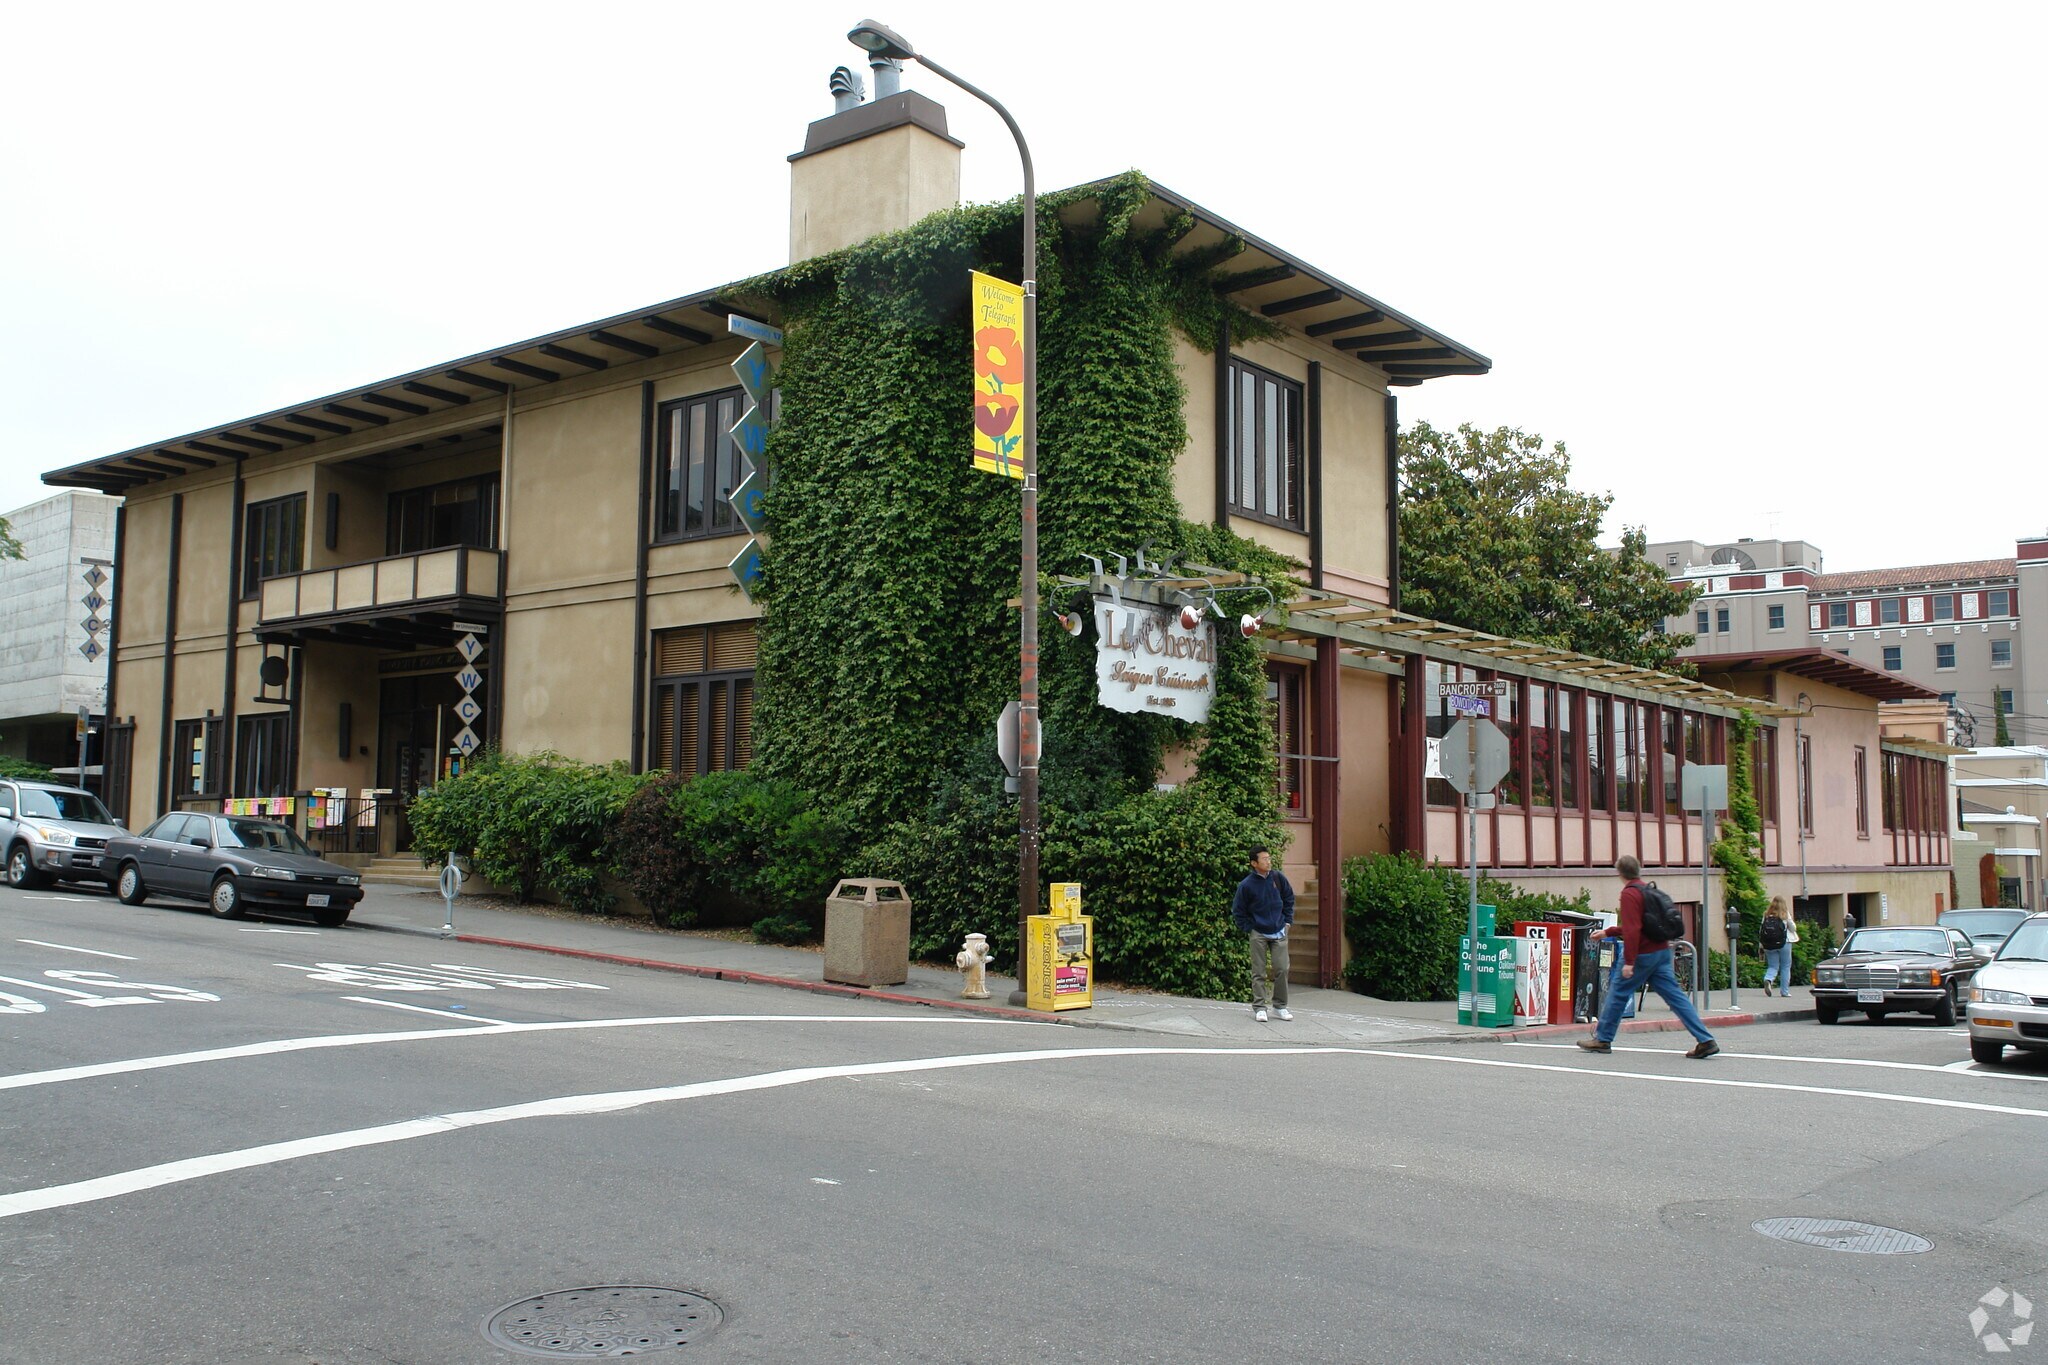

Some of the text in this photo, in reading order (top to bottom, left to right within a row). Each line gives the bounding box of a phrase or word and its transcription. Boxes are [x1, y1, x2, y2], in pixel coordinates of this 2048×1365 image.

[982, 286, 1015, 304] Welcome
[997, 301, 1004, 310] to
[981, 305, 1016, 326] Telegraph
[87, 571, 102, 655] YWCA
[1144, 620, 1216, 664] Cheval
[1111, 660, 1202, 692] Saigon Cuisine
[461, 640, 478, 750] YWCA
[1440, 683, 1488, 696] BANCROFT
[1529, 928, 1546, 939] SF
[1562, 930, 1571, 949] SF
[1475, 942, 1488, 950] he
[1043, 923, 1052, 999] CHRONICLE
[1462, 951, 1497, 962] Oaland
[1463, 963, 1495, 973] Trune
[1498, 970, 1515, 979] Tribune
[1516, 965, 1527, 973] FREE
